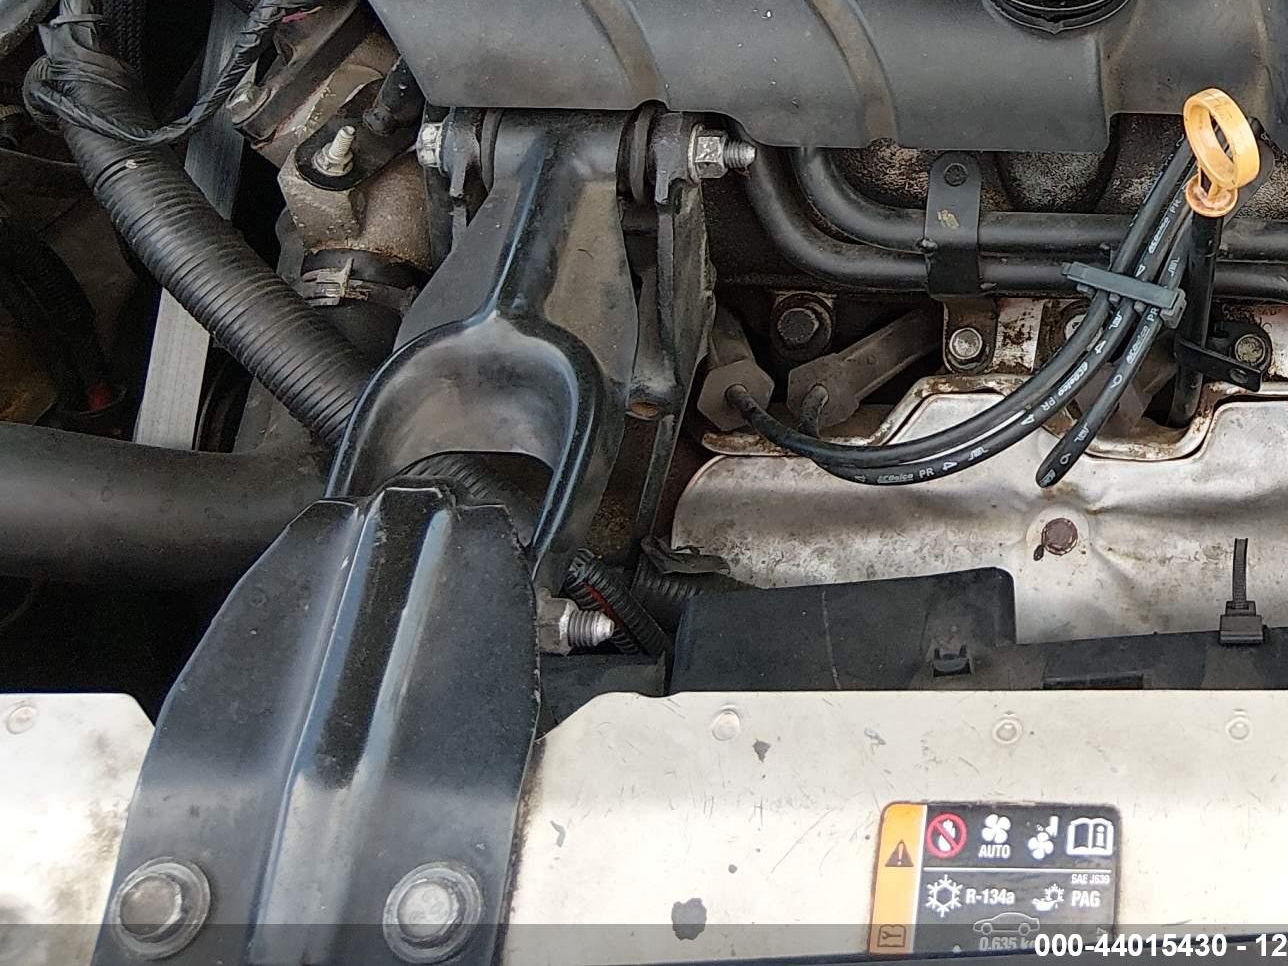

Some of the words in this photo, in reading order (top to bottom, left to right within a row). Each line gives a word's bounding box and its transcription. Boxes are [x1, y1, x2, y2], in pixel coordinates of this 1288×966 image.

[1146, 307, 1160, 322] PR
[1040, 396, 1056, 411] PR
[919, 467, 935, 479] PR
[978, 844, 1011, 859] AUTO
[1071, 873, 1088, 884] SAE
[1089, 874, 1110, 884] J639
[965, 889, 1015, 906] R-134a
[1071, 890, 1100, 907] PAG
